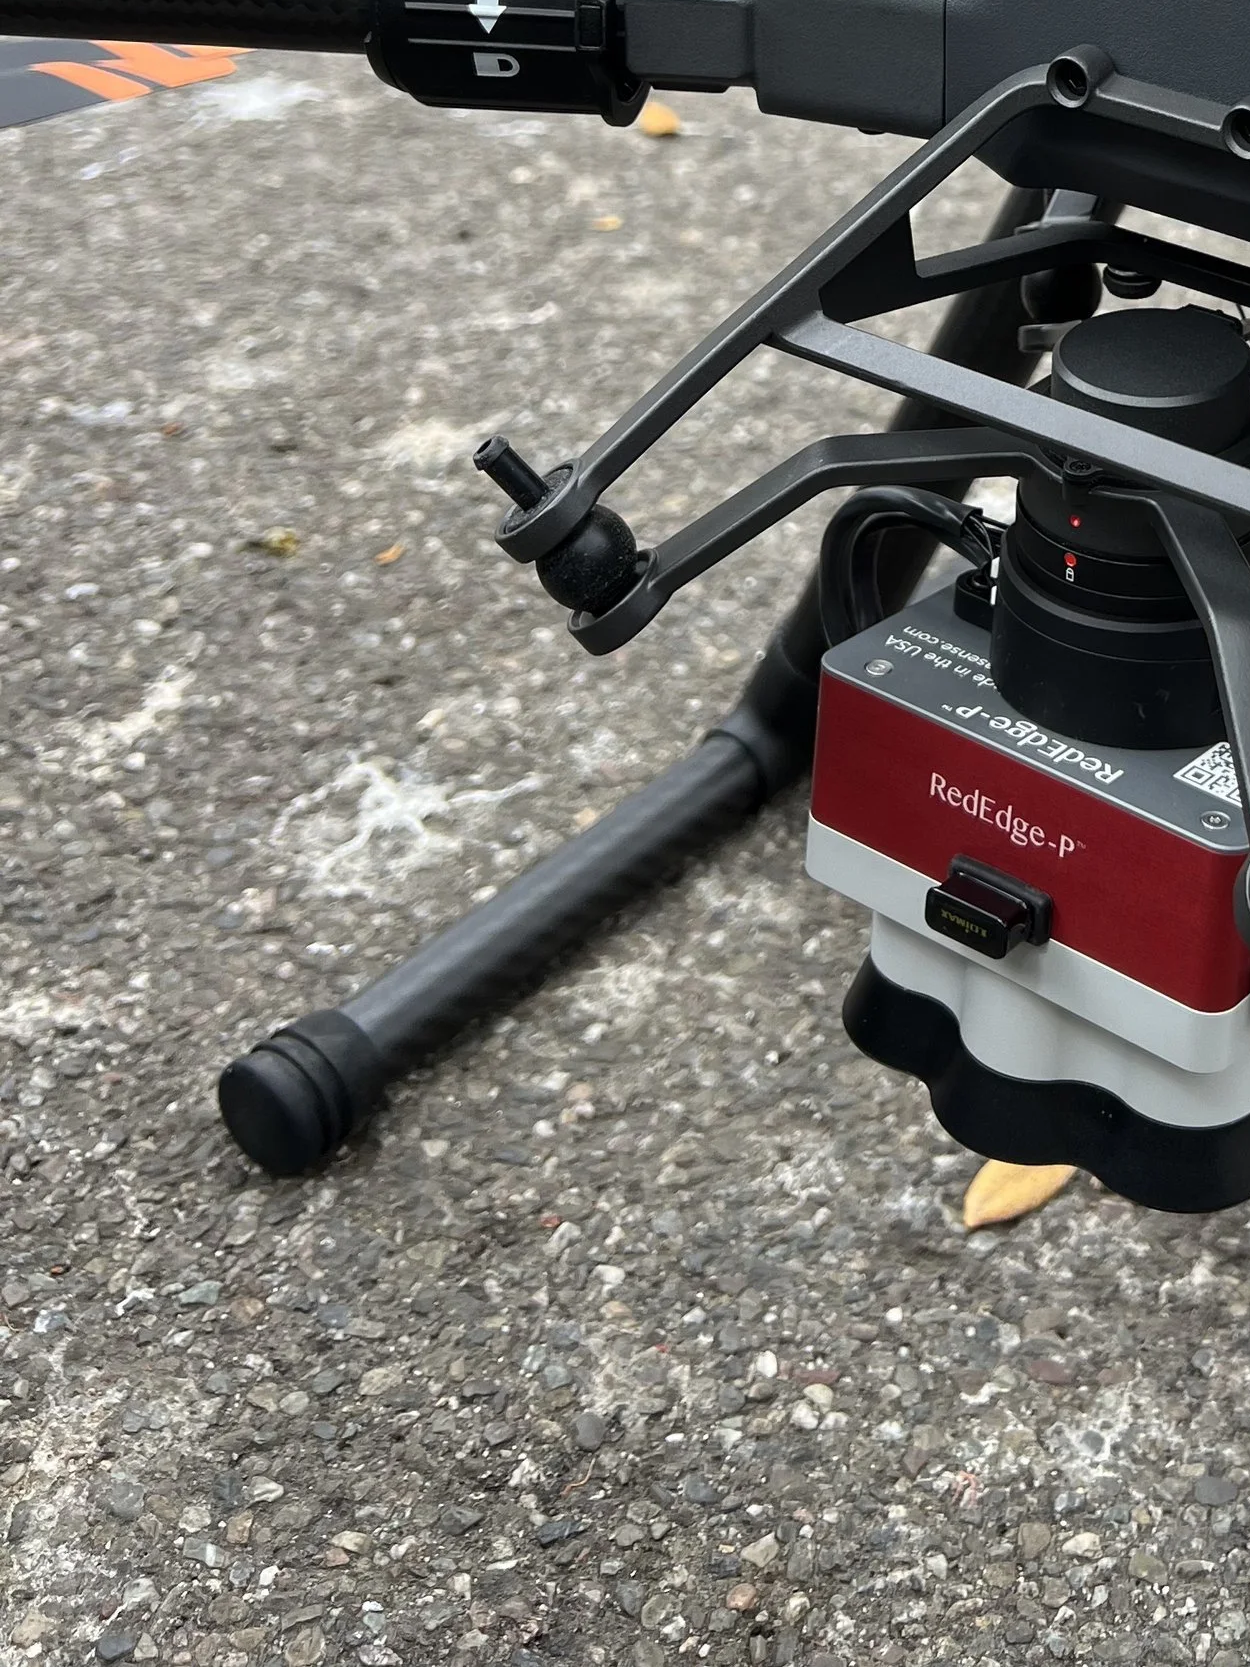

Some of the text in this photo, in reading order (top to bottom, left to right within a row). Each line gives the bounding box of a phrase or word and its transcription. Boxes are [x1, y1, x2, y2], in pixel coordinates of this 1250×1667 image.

[884, 634, 1000, 691] de in the USA
